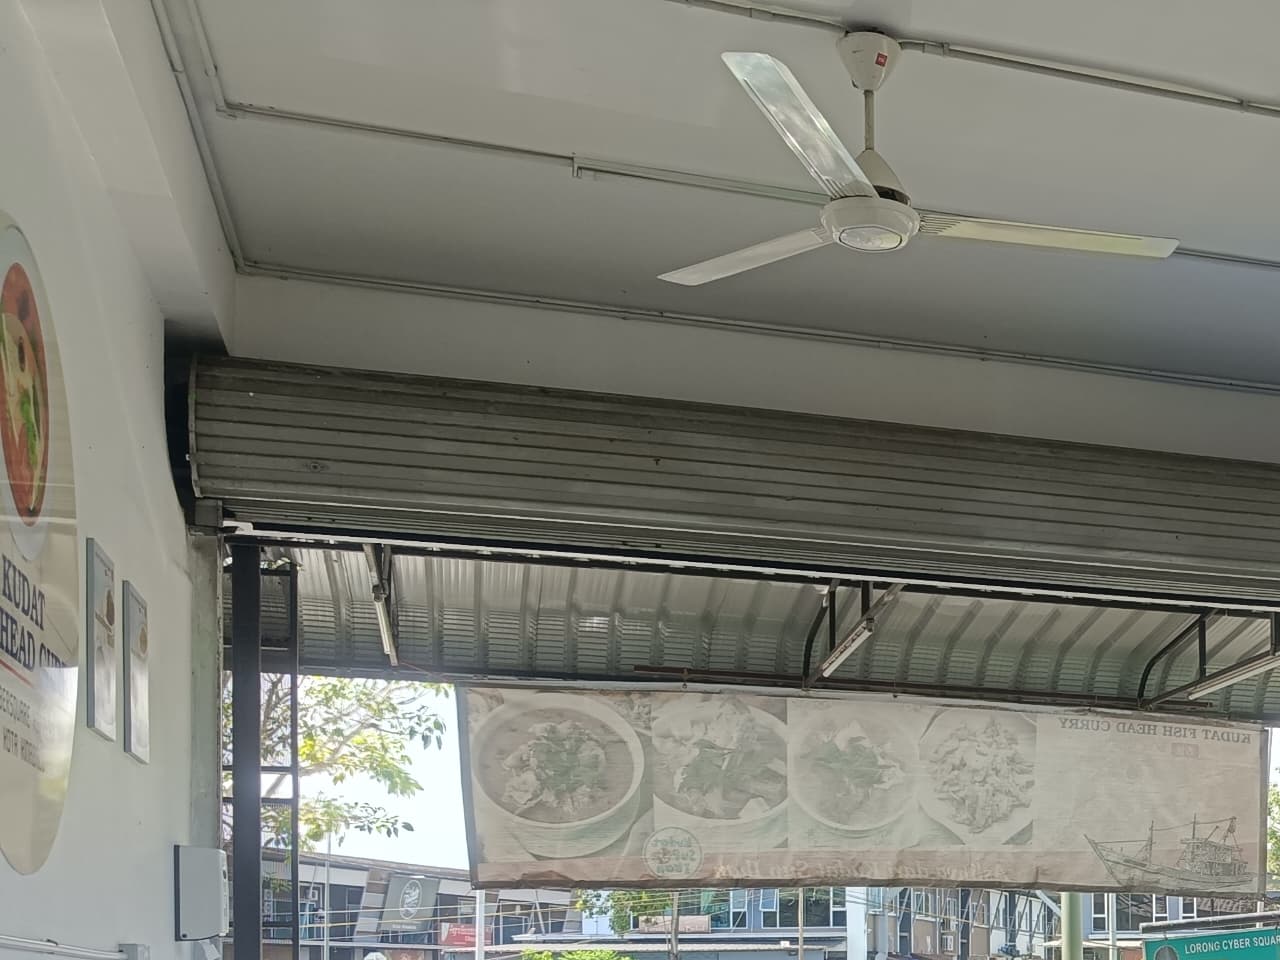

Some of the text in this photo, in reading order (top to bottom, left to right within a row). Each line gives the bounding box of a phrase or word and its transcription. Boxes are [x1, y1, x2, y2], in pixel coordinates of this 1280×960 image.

[2, 553, 45, 631] KUDAT
[0, 605, 36, 672] HEAD
[1184, 941, 1221, 955] LORONG
[1222, 937, 1251, 951] CYBER
